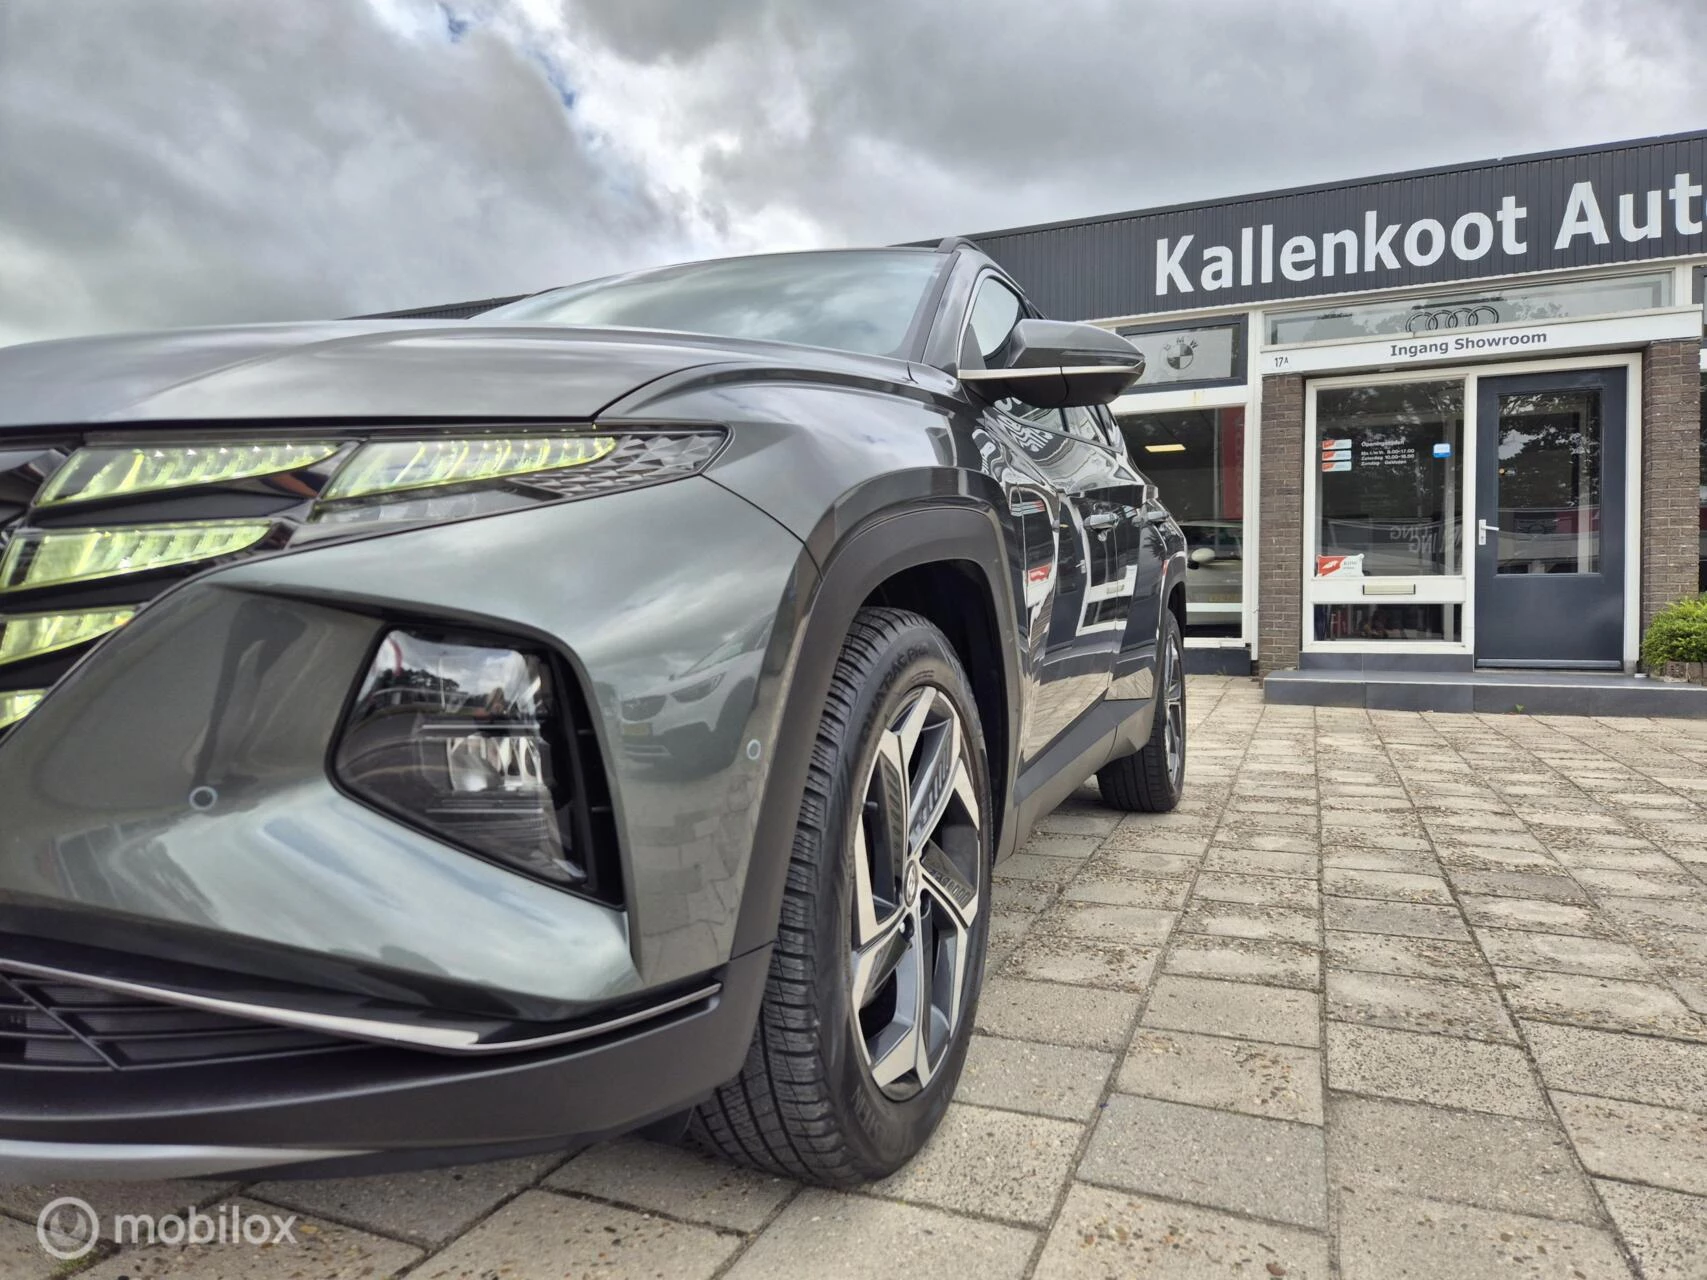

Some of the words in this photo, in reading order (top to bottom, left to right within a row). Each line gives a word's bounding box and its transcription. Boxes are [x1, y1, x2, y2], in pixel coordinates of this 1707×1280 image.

[1155, 195, 1527, 296] Kallenkoot
[1554, 173, 1707, 250] Aut
[1390, 342, 1449, 358] Ingang
[1454, 333, 1547, 350] Showroom
[1274, 356, 1289, 368] 17A
